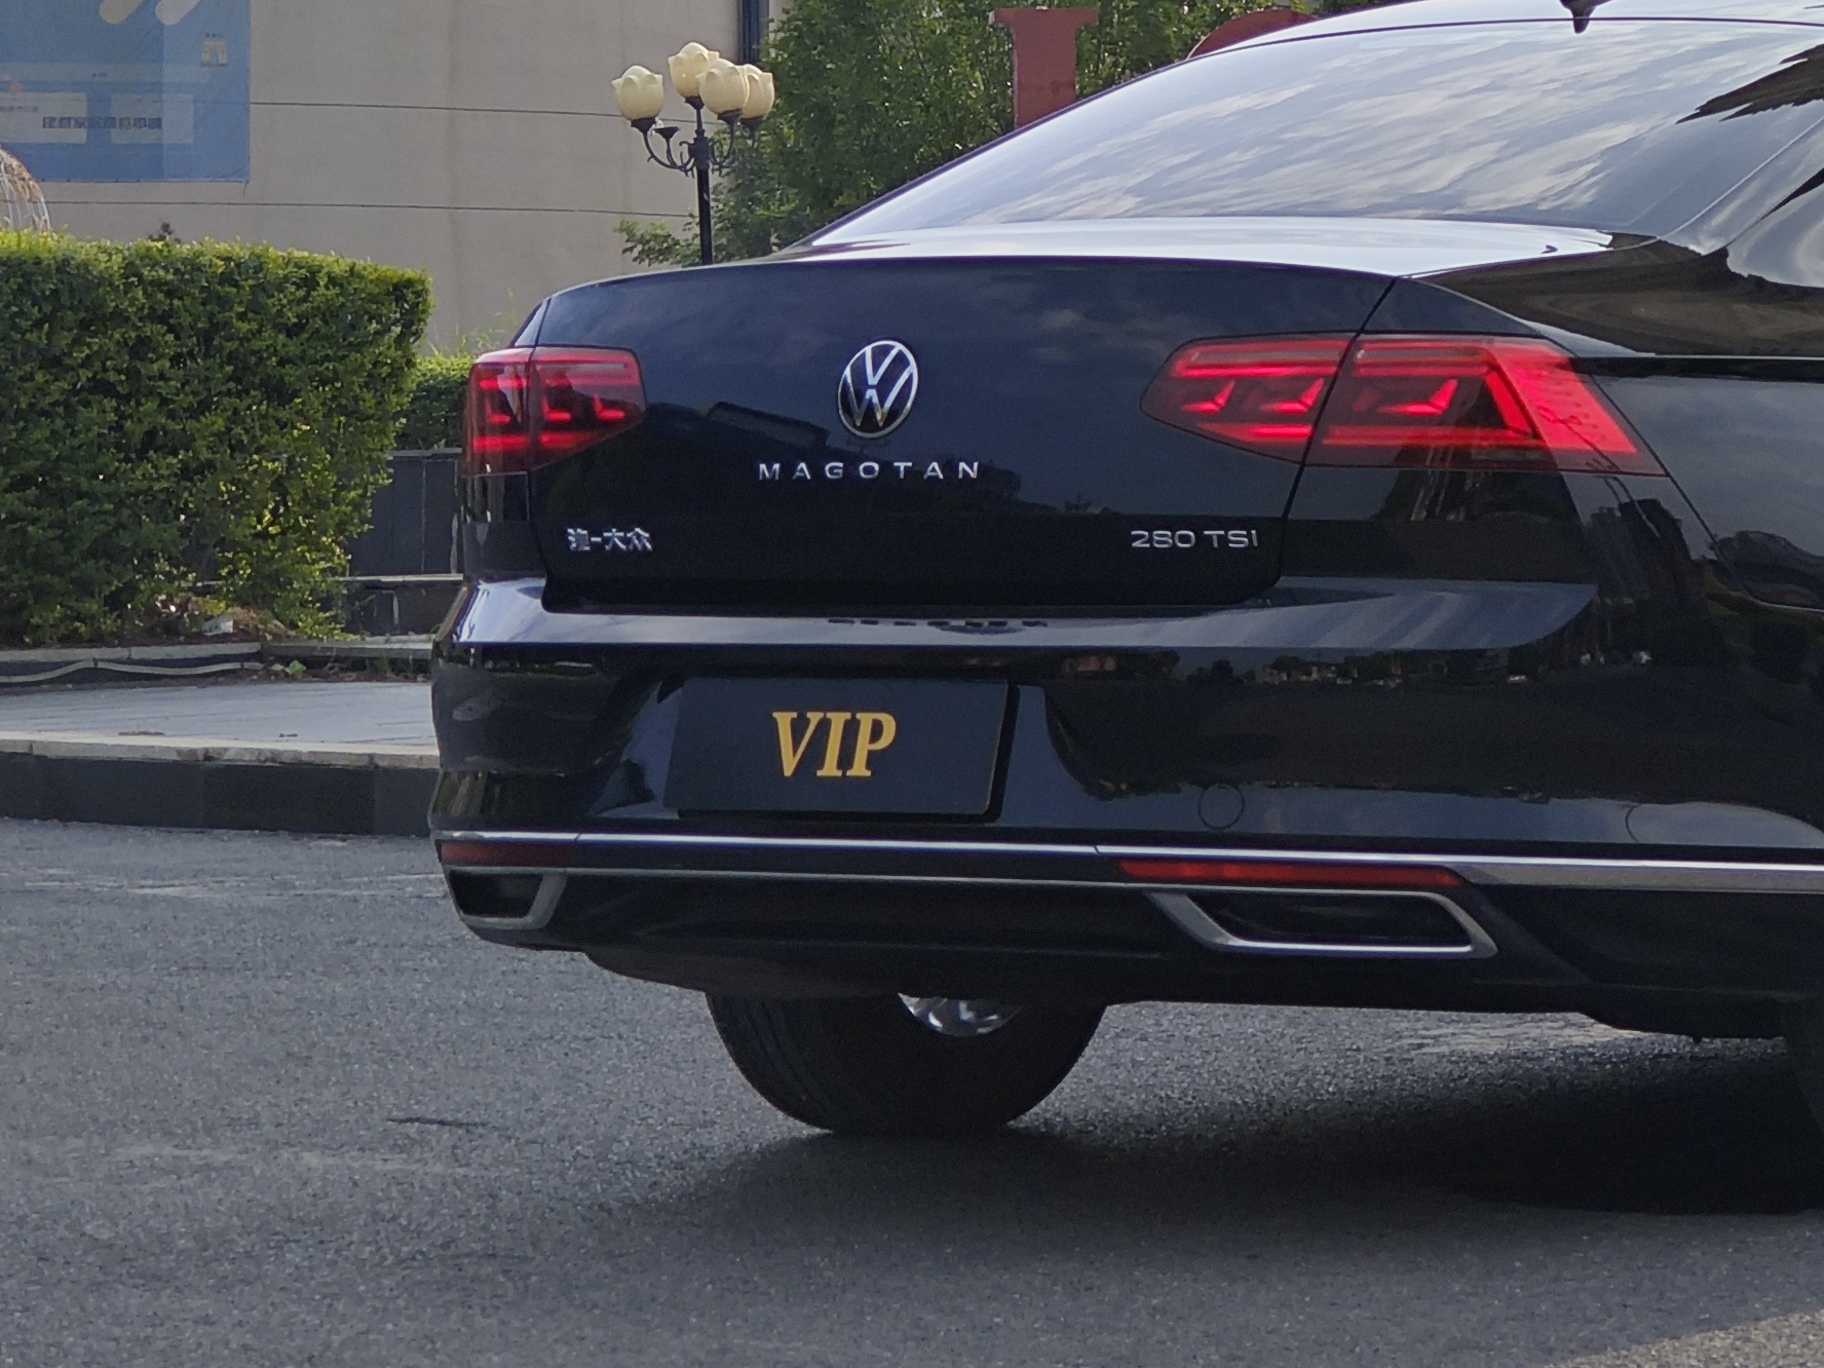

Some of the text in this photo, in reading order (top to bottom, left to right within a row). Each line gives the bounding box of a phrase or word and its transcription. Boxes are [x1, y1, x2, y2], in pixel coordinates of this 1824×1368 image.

[758, 461, 979, 480] MAGOTAN
[1130, 529, 1258, 548] 280 TSI
[772, 711, 897, 777] VIP
